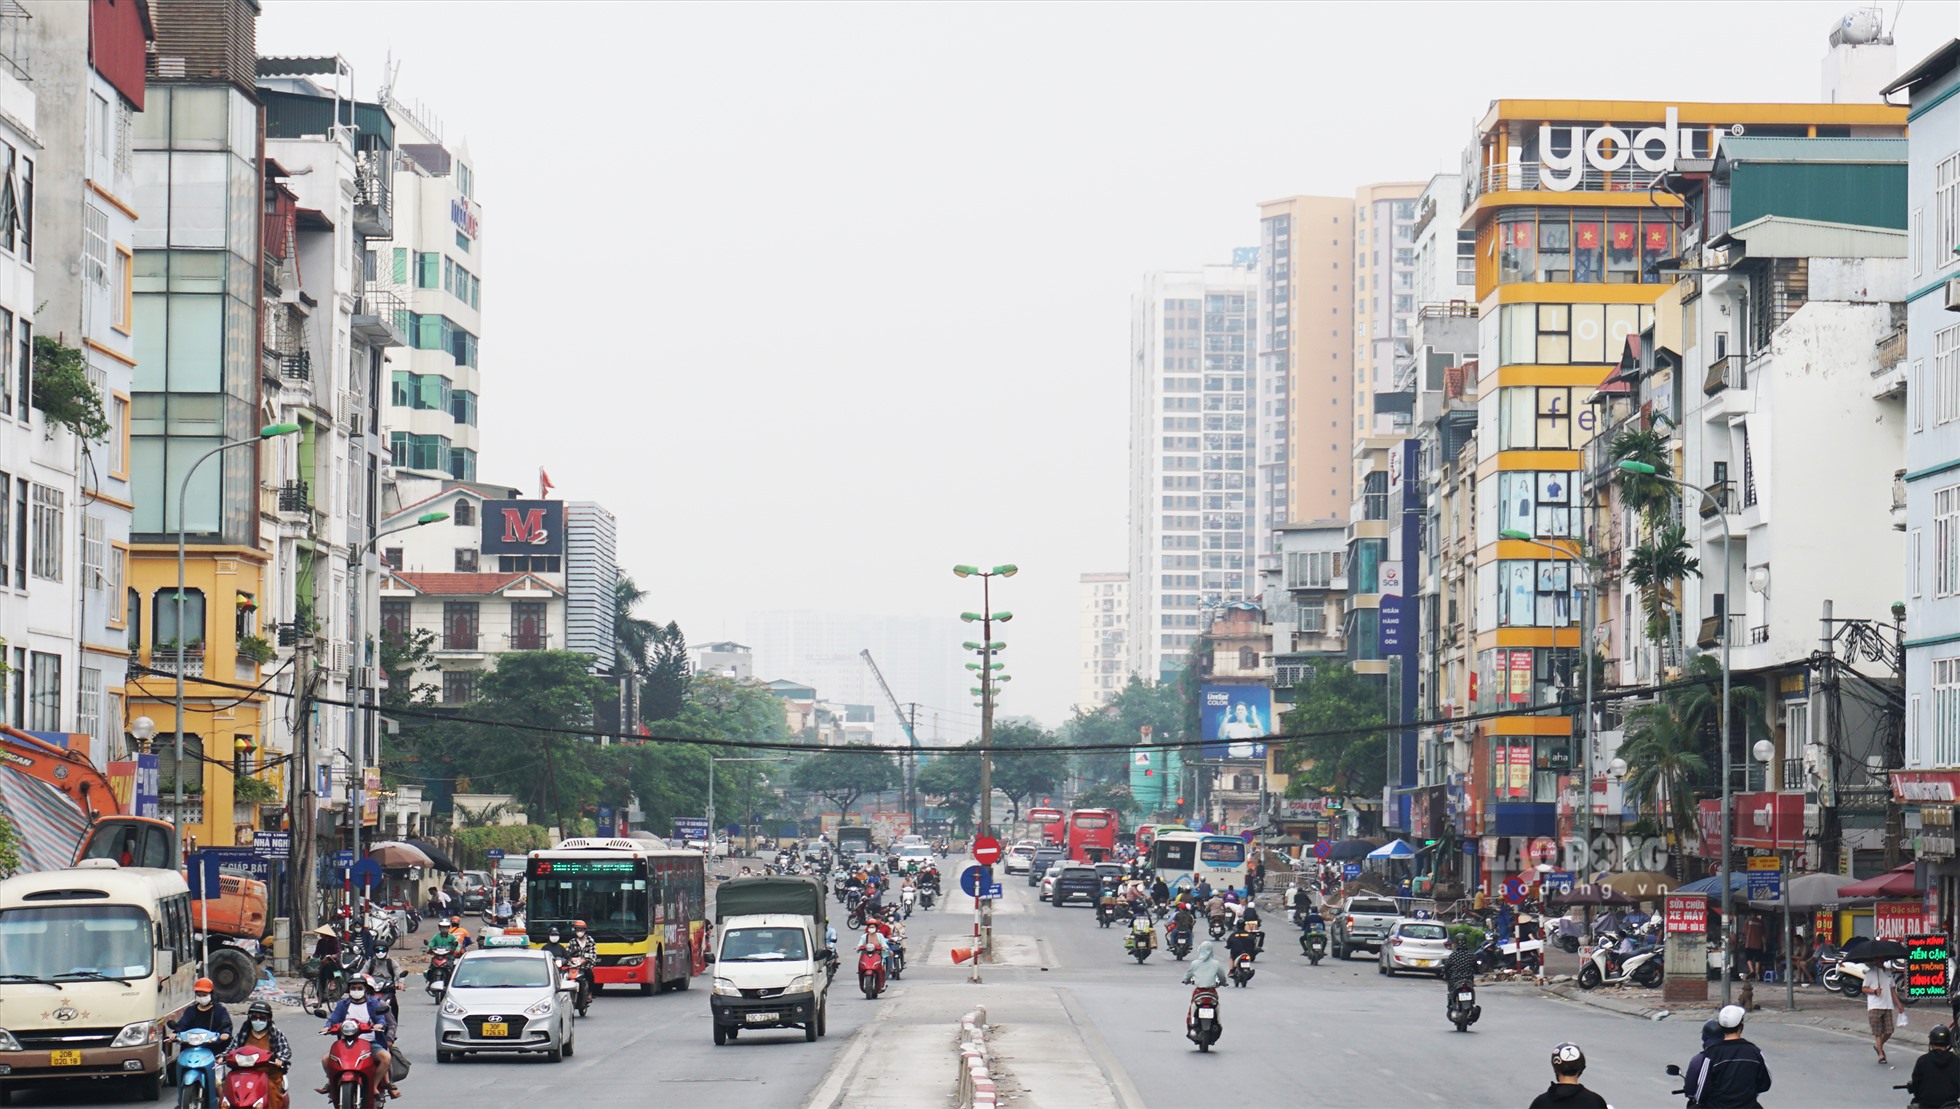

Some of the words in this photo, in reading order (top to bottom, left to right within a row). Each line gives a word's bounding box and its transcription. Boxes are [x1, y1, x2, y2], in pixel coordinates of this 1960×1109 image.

[1552, 752, 1568, 761] aha
[253, 837, 270, 847] NHÀ
[1670, 898, 1684, 909] SỬA
[1686, 900, 1705, 909] CHỮA
[1670, 911, 1681, 920] XE
[1684, 910, 1704, 920] MÁY
[1891, 906, 1904, 914] Đặc
[1879, 914, 1904, 938] BÁNH
[1926, 936, 1945, 945] KÍNH
[1928, 948, 1946, 960] CẬN
[1910, 973, 1931, 986] KÍNH
[1910, 988, 1926, 996] BỌC
[1926, 986, 1946, 995] VÀNG
